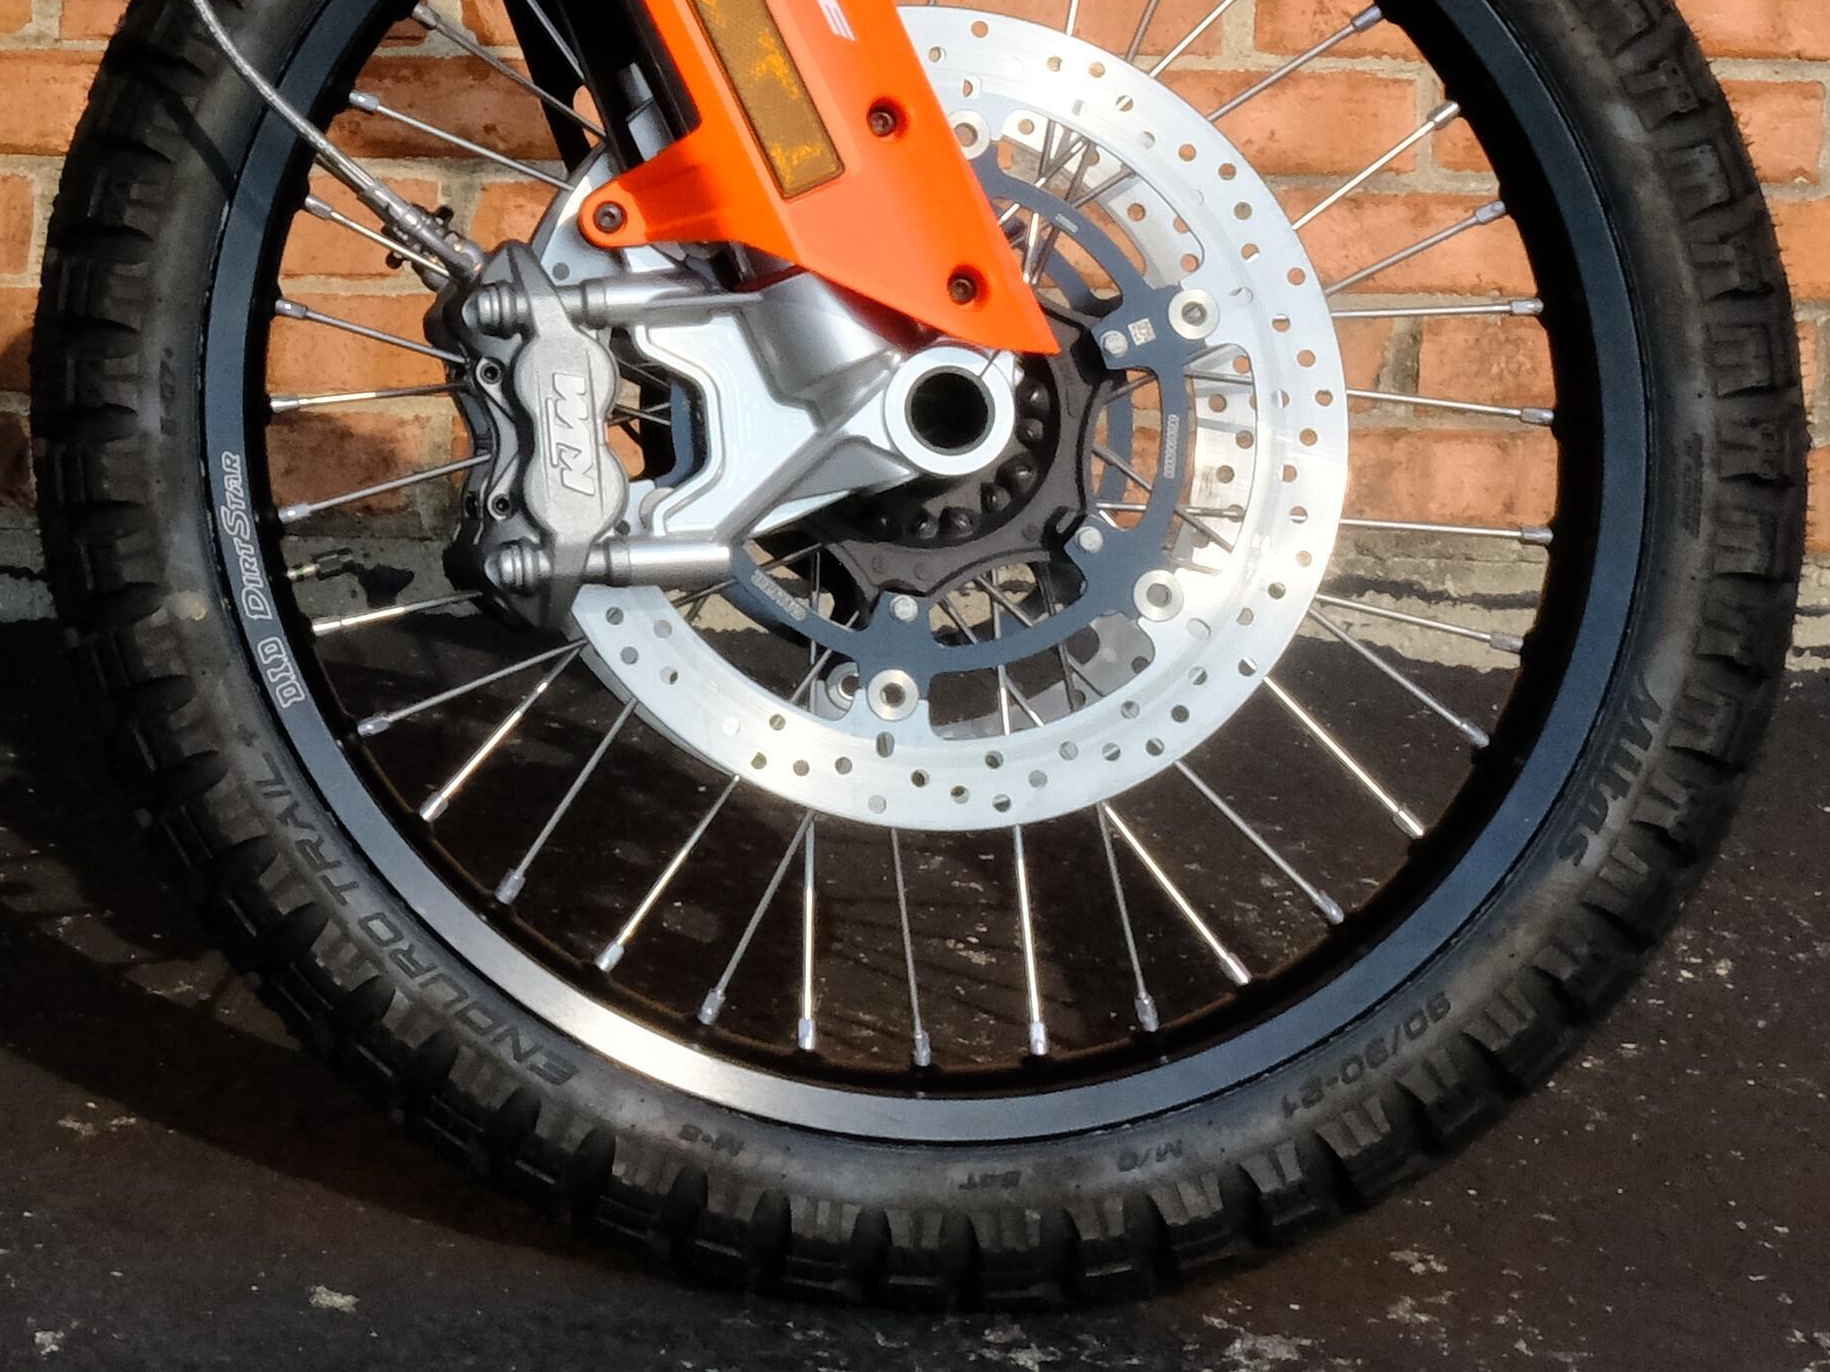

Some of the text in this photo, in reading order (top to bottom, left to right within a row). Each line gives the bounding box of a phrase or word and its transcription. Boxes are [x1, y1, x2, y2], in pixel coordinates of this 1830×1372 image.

[546, 373, 595, 495] KTM
[1552, 670, 1675, 873] Mitas
[348, 897, 581, 1093] ENDURO
[1274, 982, 1456, 1127] 90/90-21
